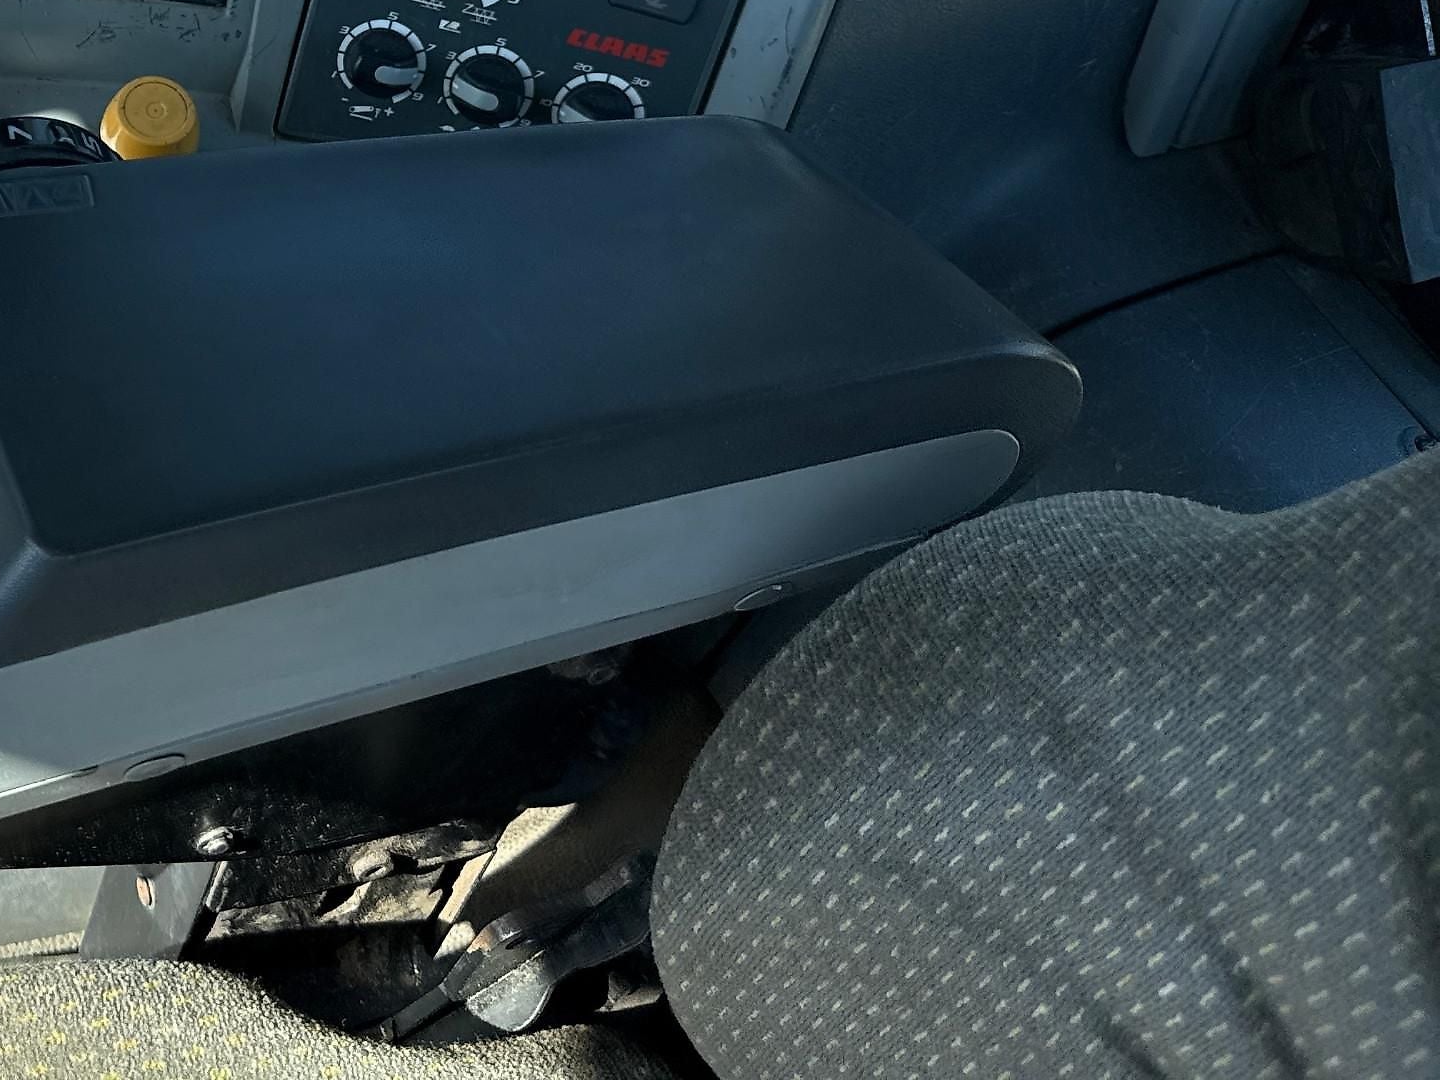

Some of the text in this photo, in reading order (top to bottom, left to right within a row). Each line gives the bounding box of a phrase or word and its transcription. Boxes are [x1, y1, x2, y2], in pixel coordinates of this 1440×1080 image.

[387, 11, 400, 21] 5
[338, 25, 350, 34] 3
[495, 37, 509, 46] 5
[425, 43, 438, 52] 7
[566, 27, 670, 68] CLAAS
[446, 51, 458, 60] 3
[573, 62, 593, 72] 20
[533, 70, 545, 79] 7
[631, 76, 651, 88] 30
[411, 92, 424, 101] 9
